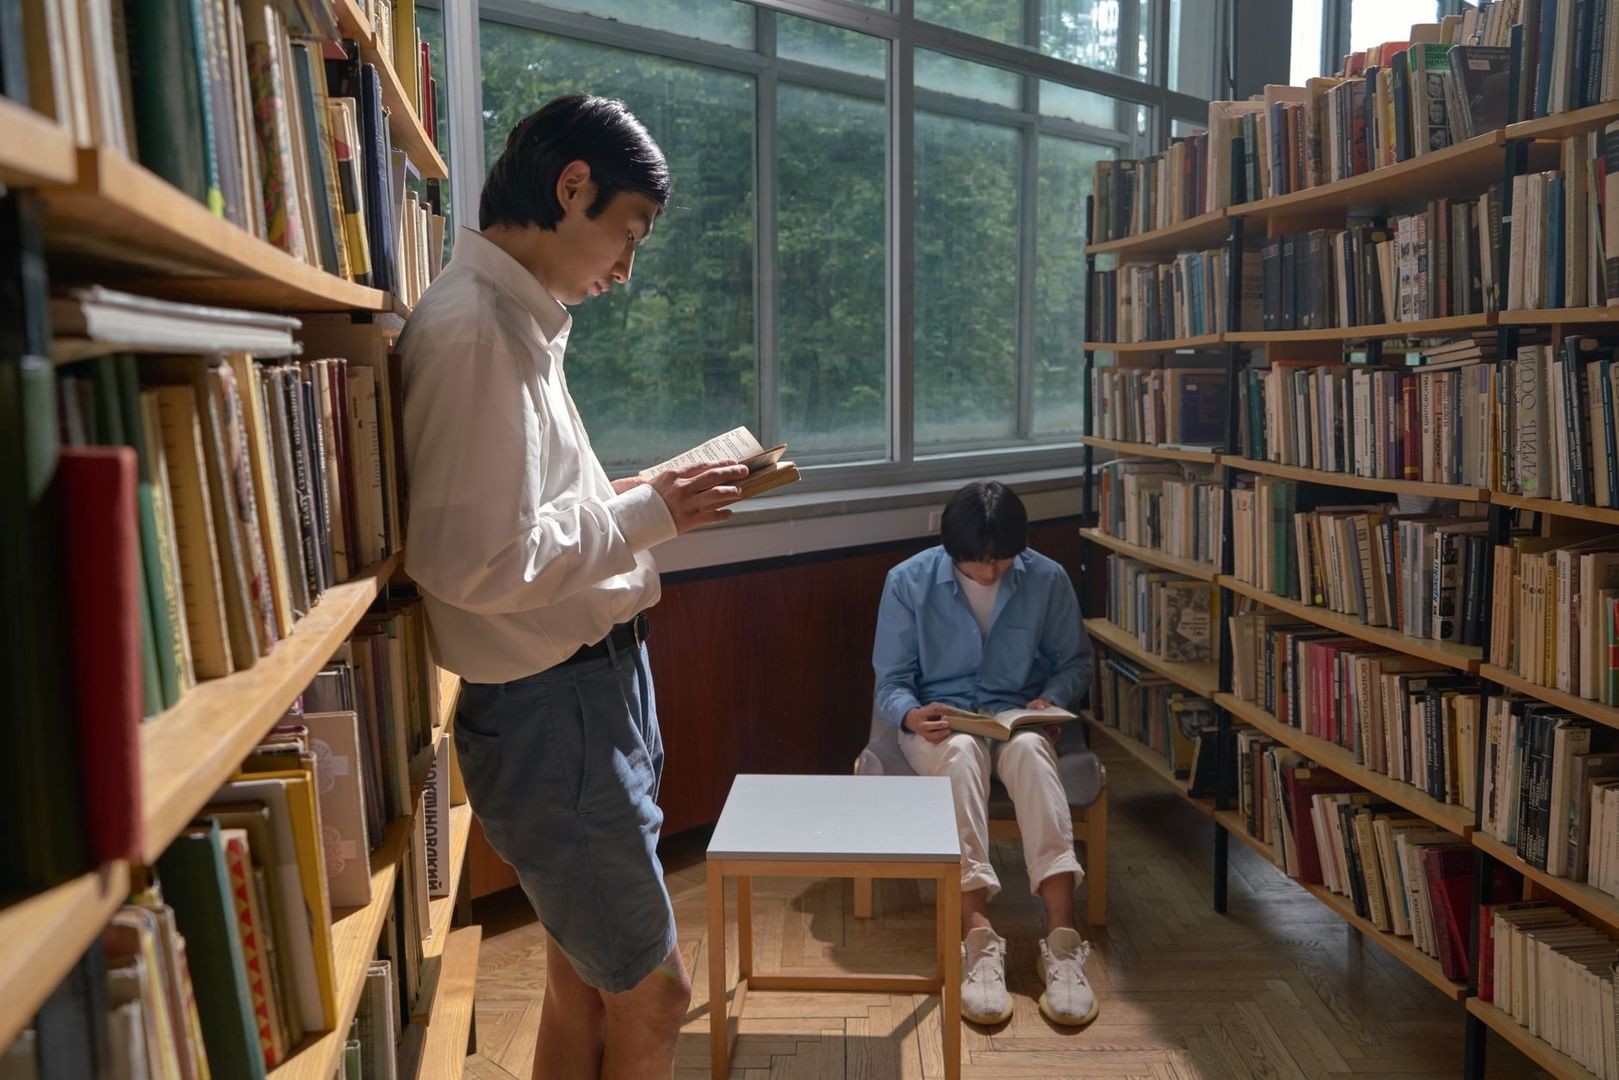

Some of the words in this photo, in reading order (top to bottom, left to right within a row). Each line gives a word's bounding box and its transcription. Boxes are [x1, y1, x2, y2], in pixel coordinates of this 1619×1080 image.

[1520, 349, 1537, 413] ОССИИ
[1521, 419, 1537, 479] АМЯТЬ
[425, 757, 443, 890] ОКТУНОВСКИЙ
